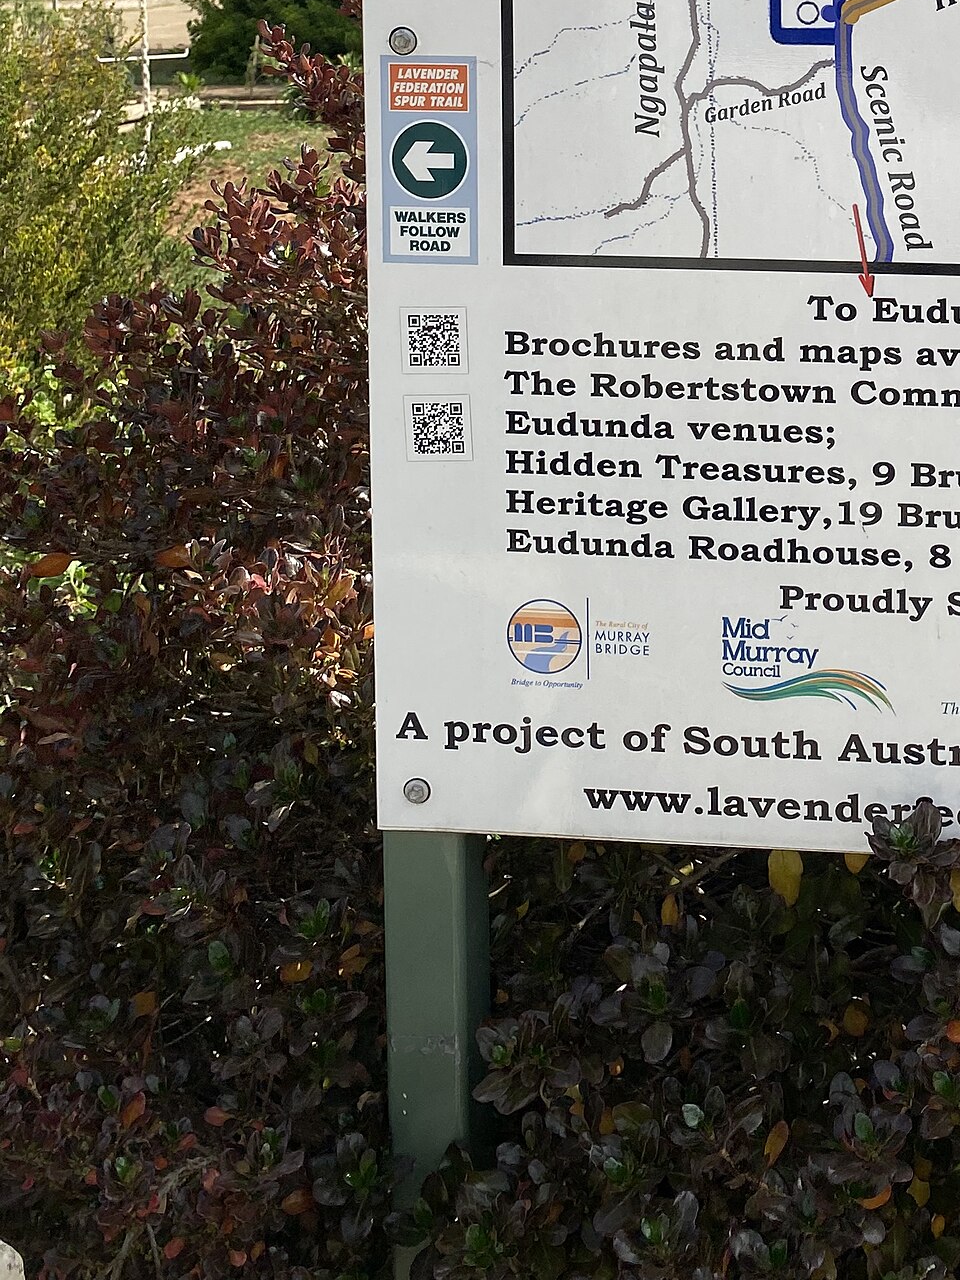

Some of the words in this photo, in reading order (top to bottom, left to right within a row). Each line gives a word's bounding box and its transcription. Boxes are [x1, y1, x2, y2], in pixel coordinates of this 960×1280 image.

[398, 68, 459, 80] LAVENDER
[630, 2, 667, 138] Ngapala
[393, 81, 464, 94] FEDERATION
[394, 95, 425, 107] SPUR
[430, 96, 463, 108] TRAIL
[705, 98, 772, 124] Garden
[778, 82, 826, 108] Road
[860, 65, 905, 163] Scenic
[888, 171, 933, 251] Road
[394, 211, 466, 223] WALKERS
[400, 226, 460, 238] FOLLOW
[410, 240, 451, 252] ROAD
[807, 295, 857, 321] To
[504, 331, 701, 360] Brochures
[714, 337, 785, 362] and
[799, 343, 902, 371] maps
[504, 370, 576, 396] The
[591, 374, 836, 404] Robertstown
[505, 410, 674, 440] Eudunda
[687, 423, 836, 449] venues;
[505, 450, 642, 478] Hidden
[655, 454, 857, 490] Treasures,
[872, 462, 895, 487] 9
[505, 490, 668, 524] Heritage
[506, 529, 674, 558] Eudunda
[689, 535, 913, 572] Roadhouse,
[929, 545, 952, 569] 8
[779, 585, 932, 621] Proudly
[595, 631, 650, 643] MURRAY
[627, 622, 640, 630] City
[642, 622, 648, 630] of
[722, 616, 770, 639] Mid
[595, 643, 649, 656] BRIDGE
[722, 640, 819, 669] Murray
[722, 663, 781, 678] Council
[511, 678, 533, 688] Bridge
[543, 680, 583, 690] Opportunity
[395, 711, 428, 740] A
[444, 716, 606, 754] project
[622, 722, 666, 753] of
[683, 725, 822, 761] South
